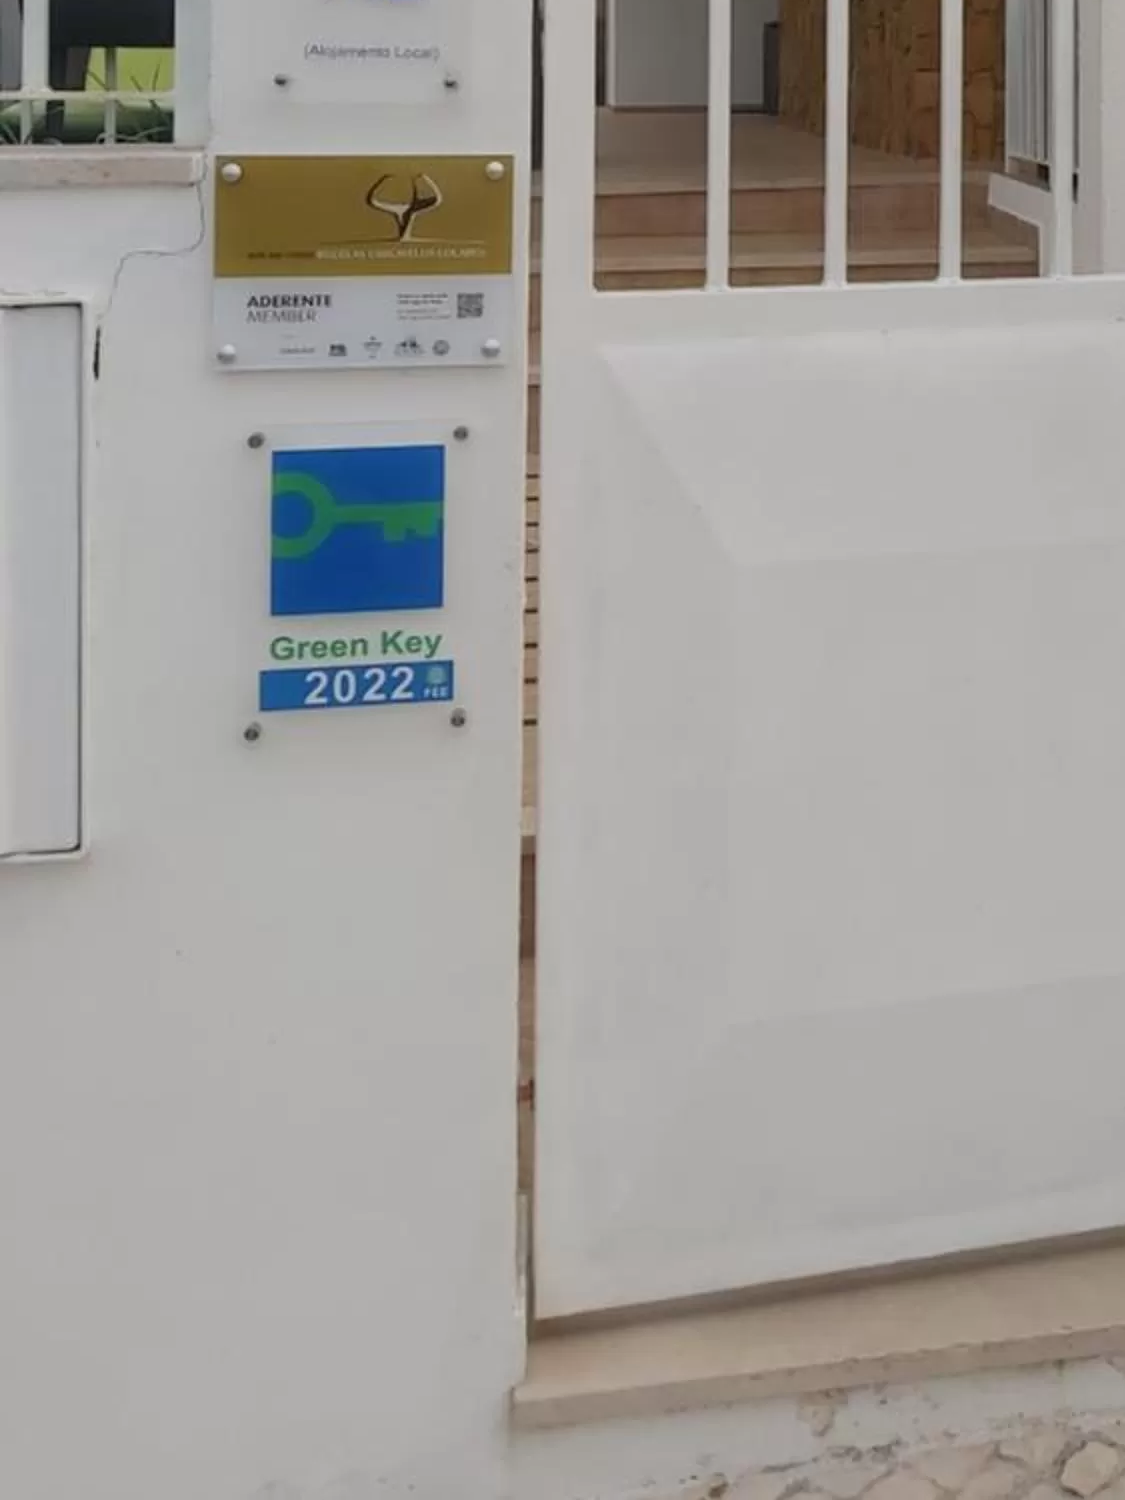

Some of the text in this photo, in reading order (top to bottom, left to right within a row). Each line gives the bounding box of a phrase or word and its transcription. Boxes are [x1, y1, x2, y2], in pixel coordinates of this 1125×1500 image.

[246, 294, 332, 309] ADERENTE
[246, 309, 318, 323] MEMBER
[269, 630, 443, 661] Green Key
[304, 666, 416, 705] 2022
